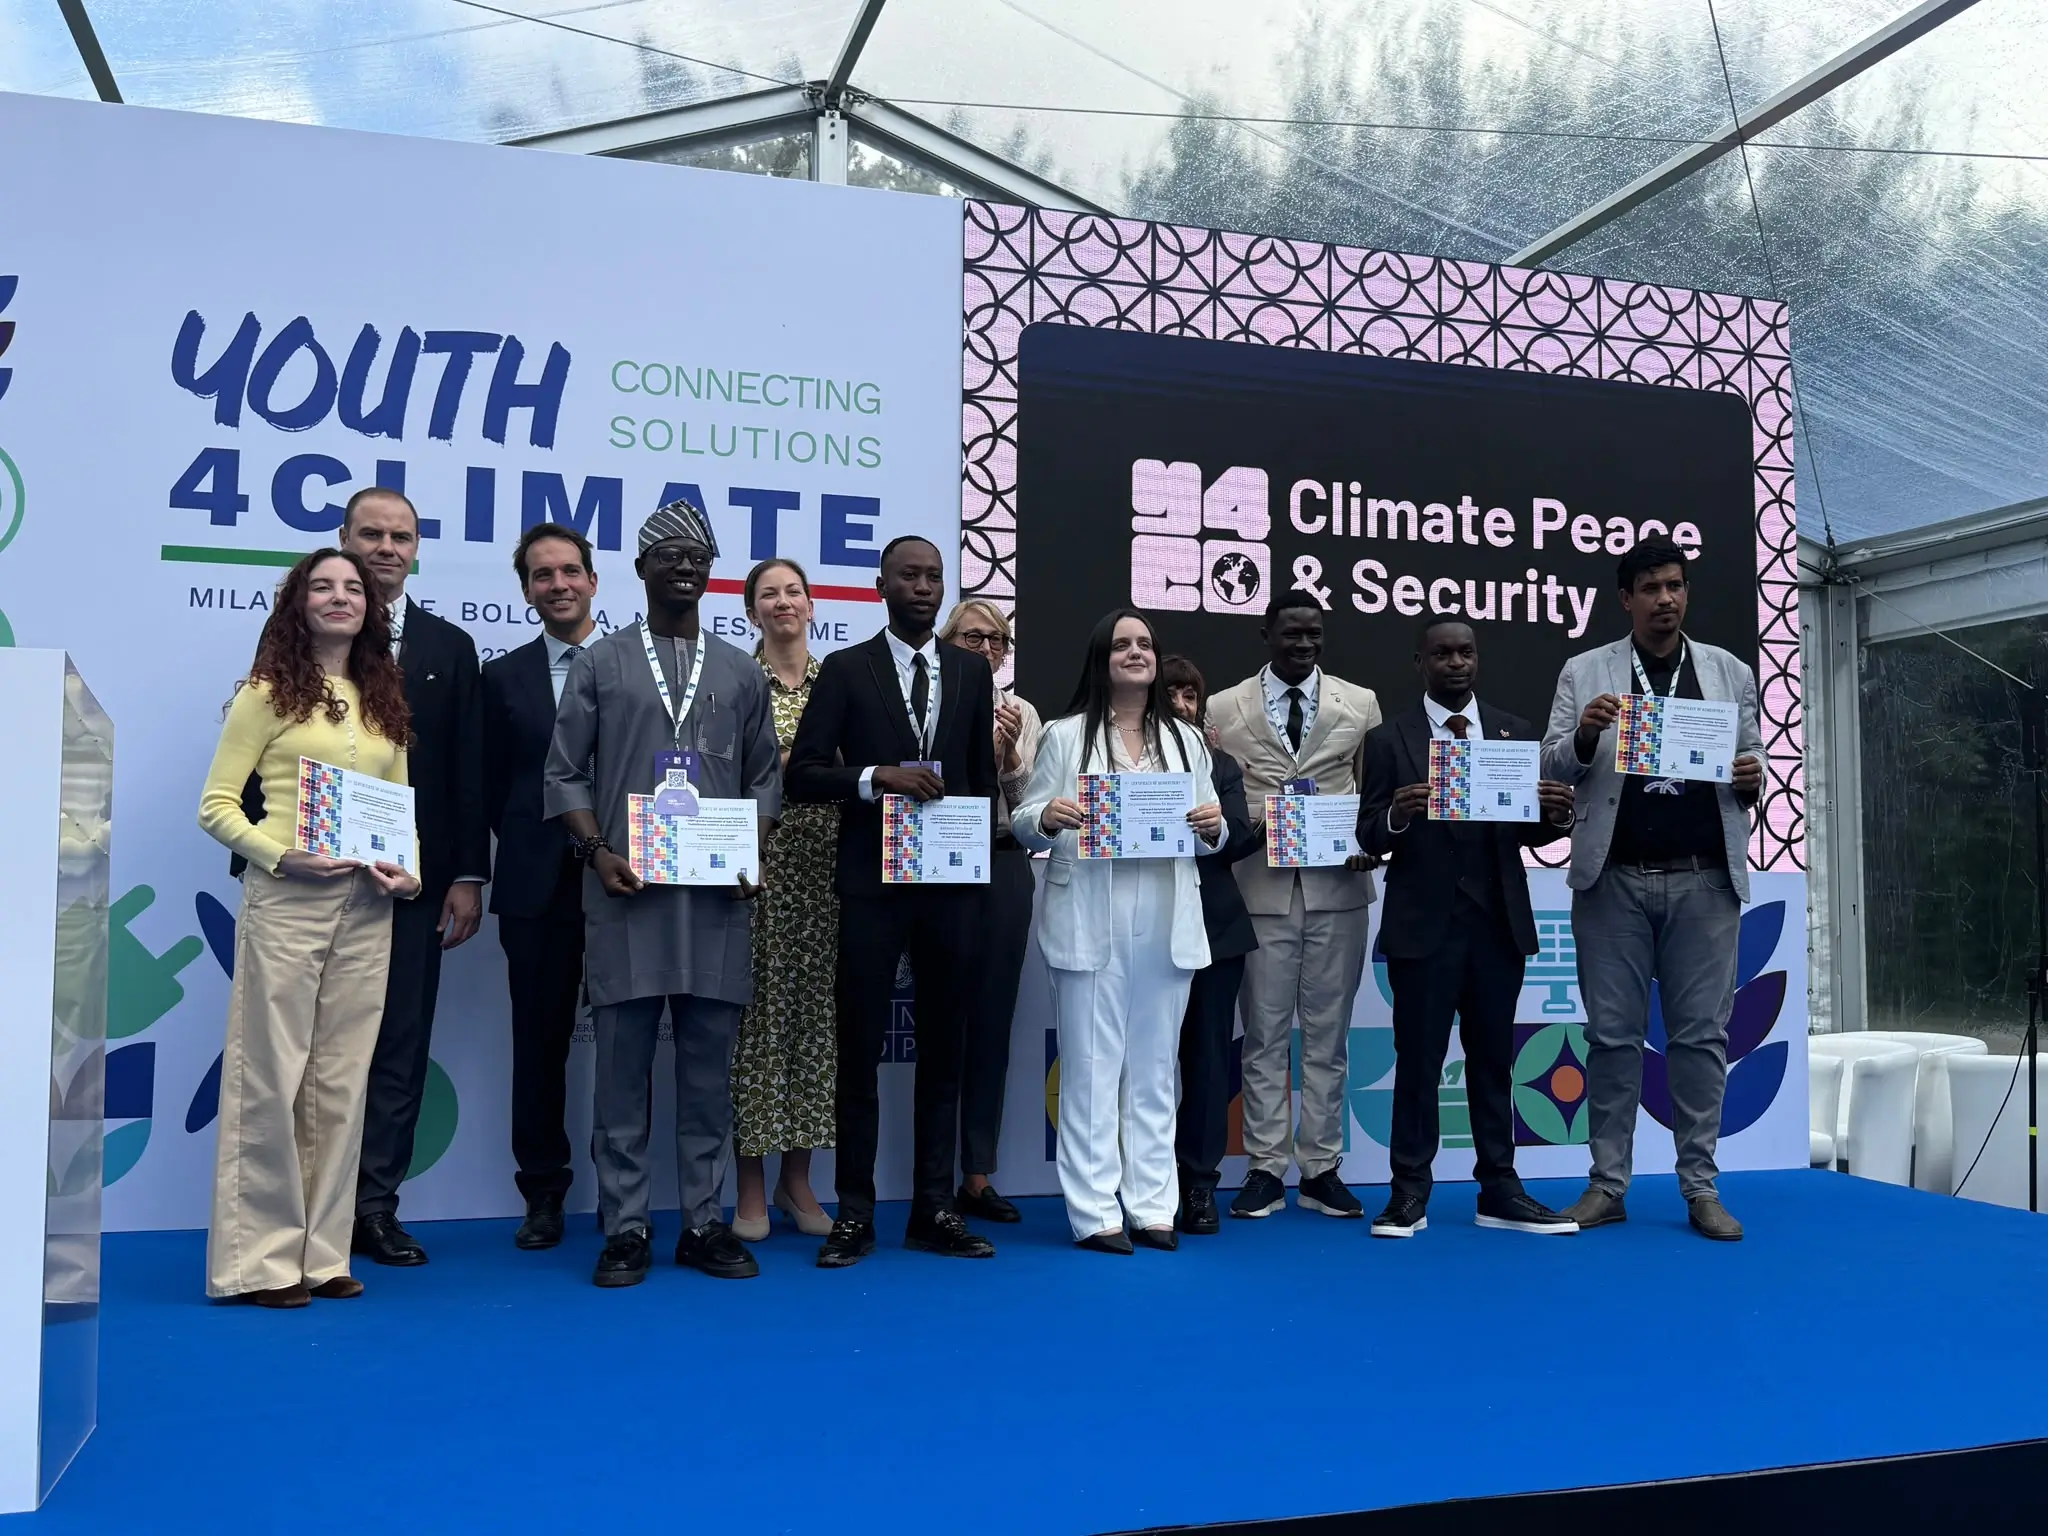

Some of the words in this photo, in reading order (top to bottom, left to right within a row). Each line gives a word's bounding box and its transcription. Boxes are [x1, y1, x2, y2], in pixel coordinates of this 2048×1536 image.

[171, 309, 571, 450] YOUTH
[611, 359, 882, 415] CONNECTING
[608, 415, 882, 469] SOLUTIONS
[169, 447, 882, 568] 4CLIMTE
[1289, 478, 1516, 547] Climate
[189, 587, 278, 611] MILA
[1290, 554, 1333, 611] &
[1351, 558, 1597, 639] Security
